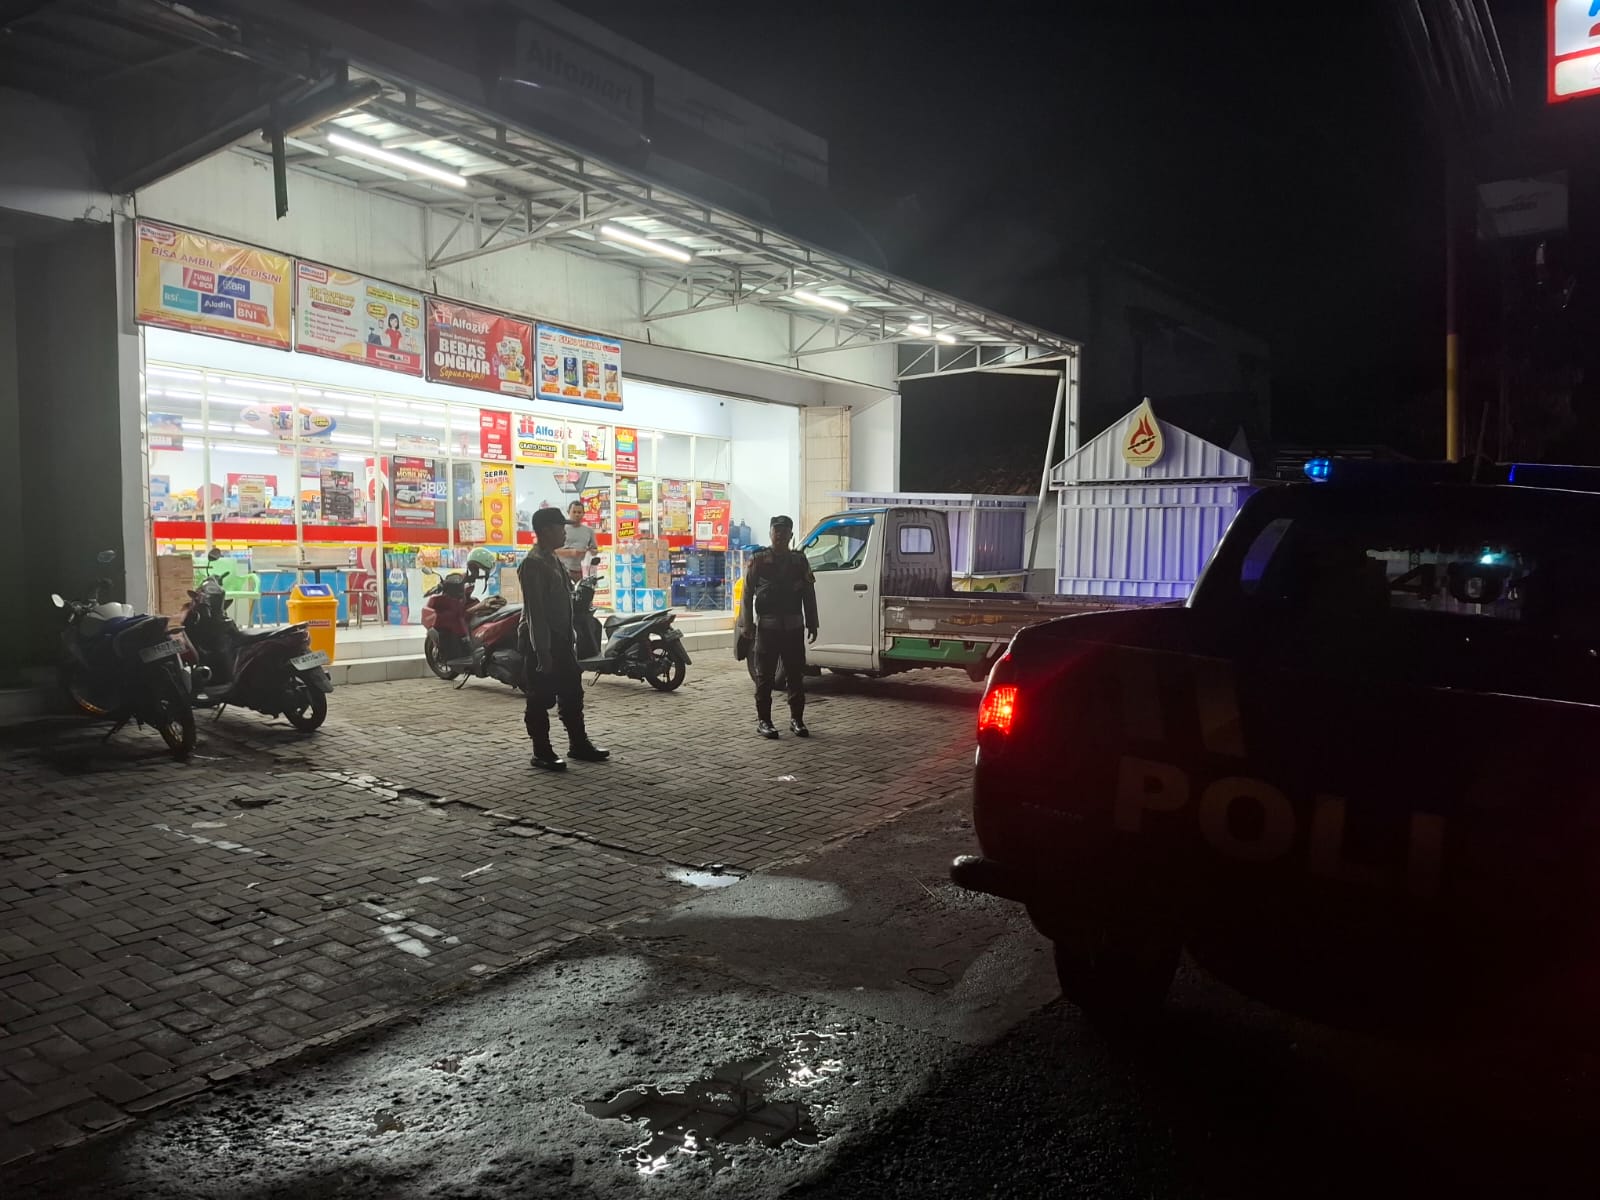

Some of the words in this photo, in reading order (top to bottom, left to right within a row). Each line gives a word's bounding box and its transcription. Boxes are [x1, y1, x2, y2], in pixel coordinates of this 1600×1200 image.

[526, 40, 632, 110] Alfamart
[152, 247, 177, 259] BISA
[181, 254, 215, 269] AMBIL
[251, 271, 282, 283] DISINI
[193, 273, 212, 282] TUNAI
[231, 282, 246, 292] BRI
[204, 299, 232, 310] Aladin
[238, 309, 257, 320] BNI
[452, 318, 490, 334] Alfagift
[439, 338, 486, 360] BEBAS
[434, 351, 491, 376] ONGKIR
[519, 442, 537, 450] GRATIS
[484, 470, 509, 478] SERBA
